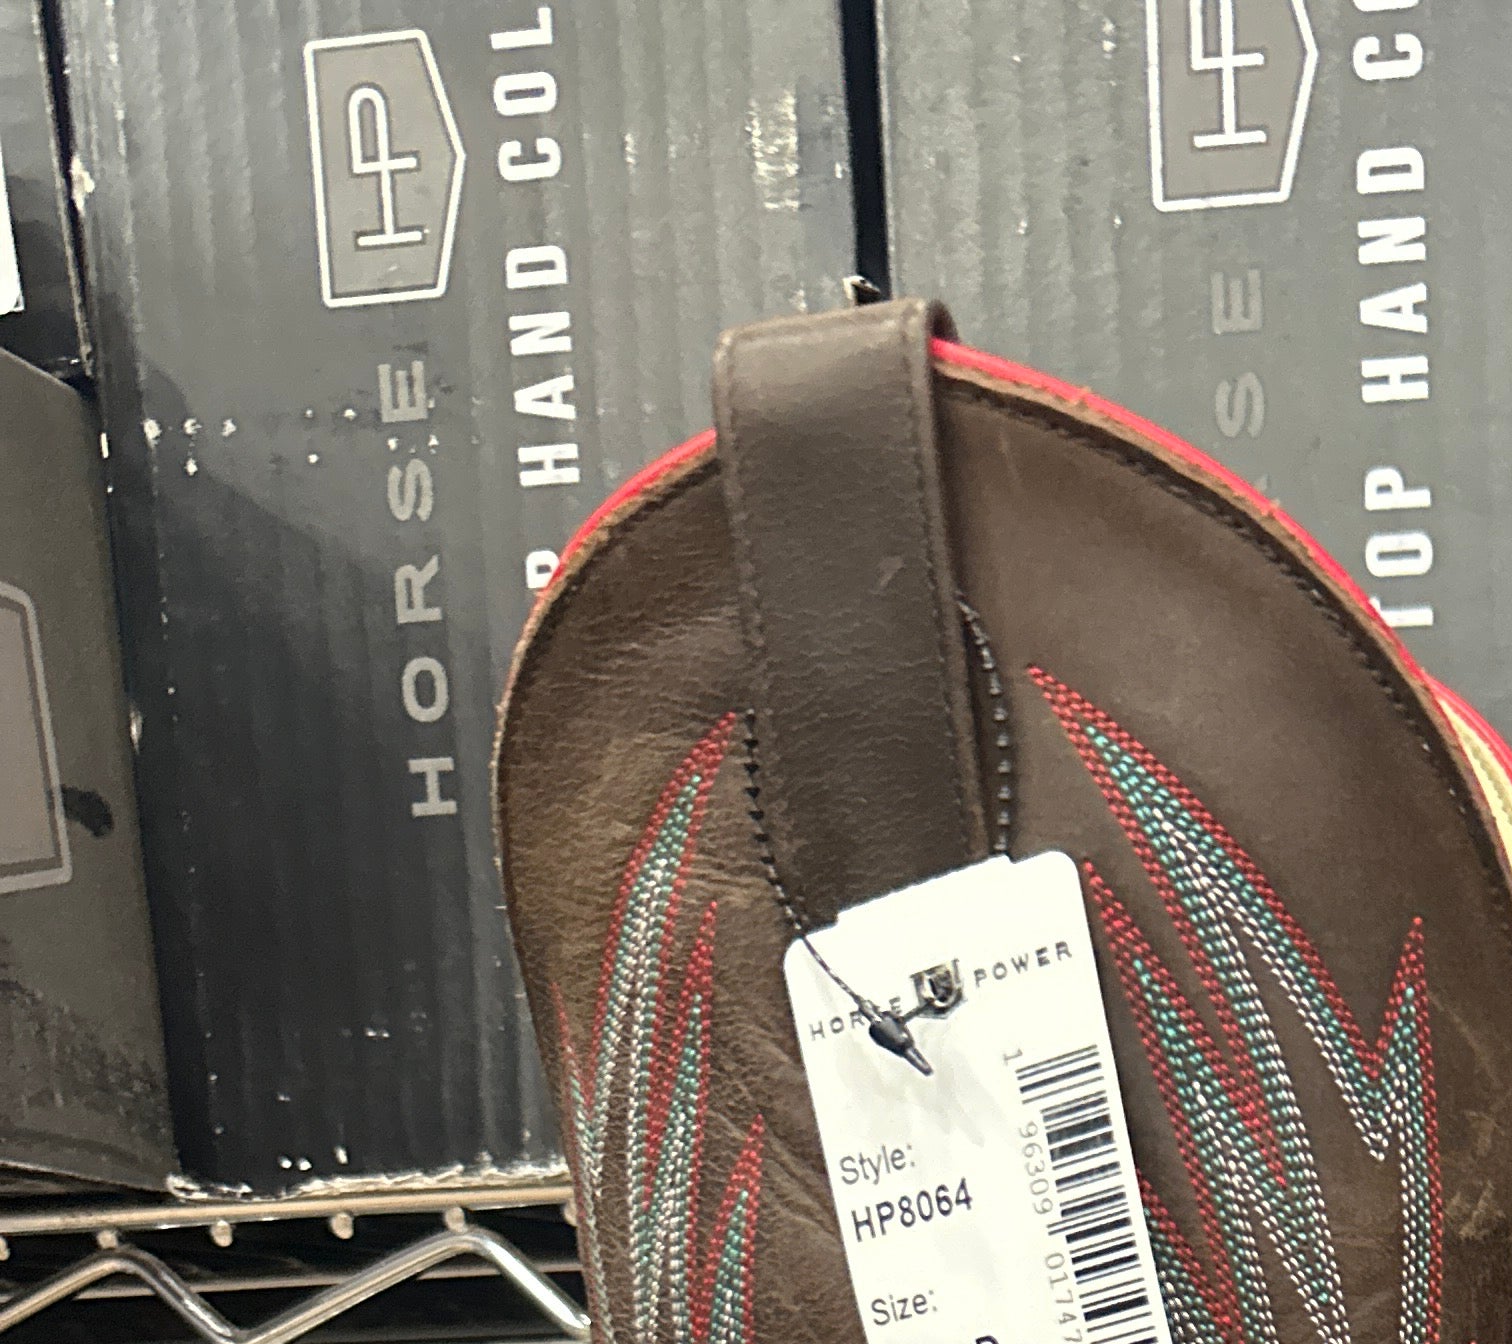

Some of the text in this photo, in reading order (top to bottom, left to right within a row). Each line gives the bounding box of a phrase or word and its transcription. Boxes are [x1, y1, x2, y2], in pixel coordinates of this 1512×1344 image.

[1357, 146, 1430, 403] HAND
[505, 243, 582, 487] HAND
[378, 358, 459, 817] HORSE
[809, 996, 903, 1042] HORE
[972, 940, 1073, 989] POWER
[840, 1142, 917, 1187] Style:
[850, 1178, 975, 1243] HP8064
[1018, 1120, 1055, 1216] 96309
[1043, 1251, 1084, 1344] 01747
[871, 1290, 938, 1328] Size:
